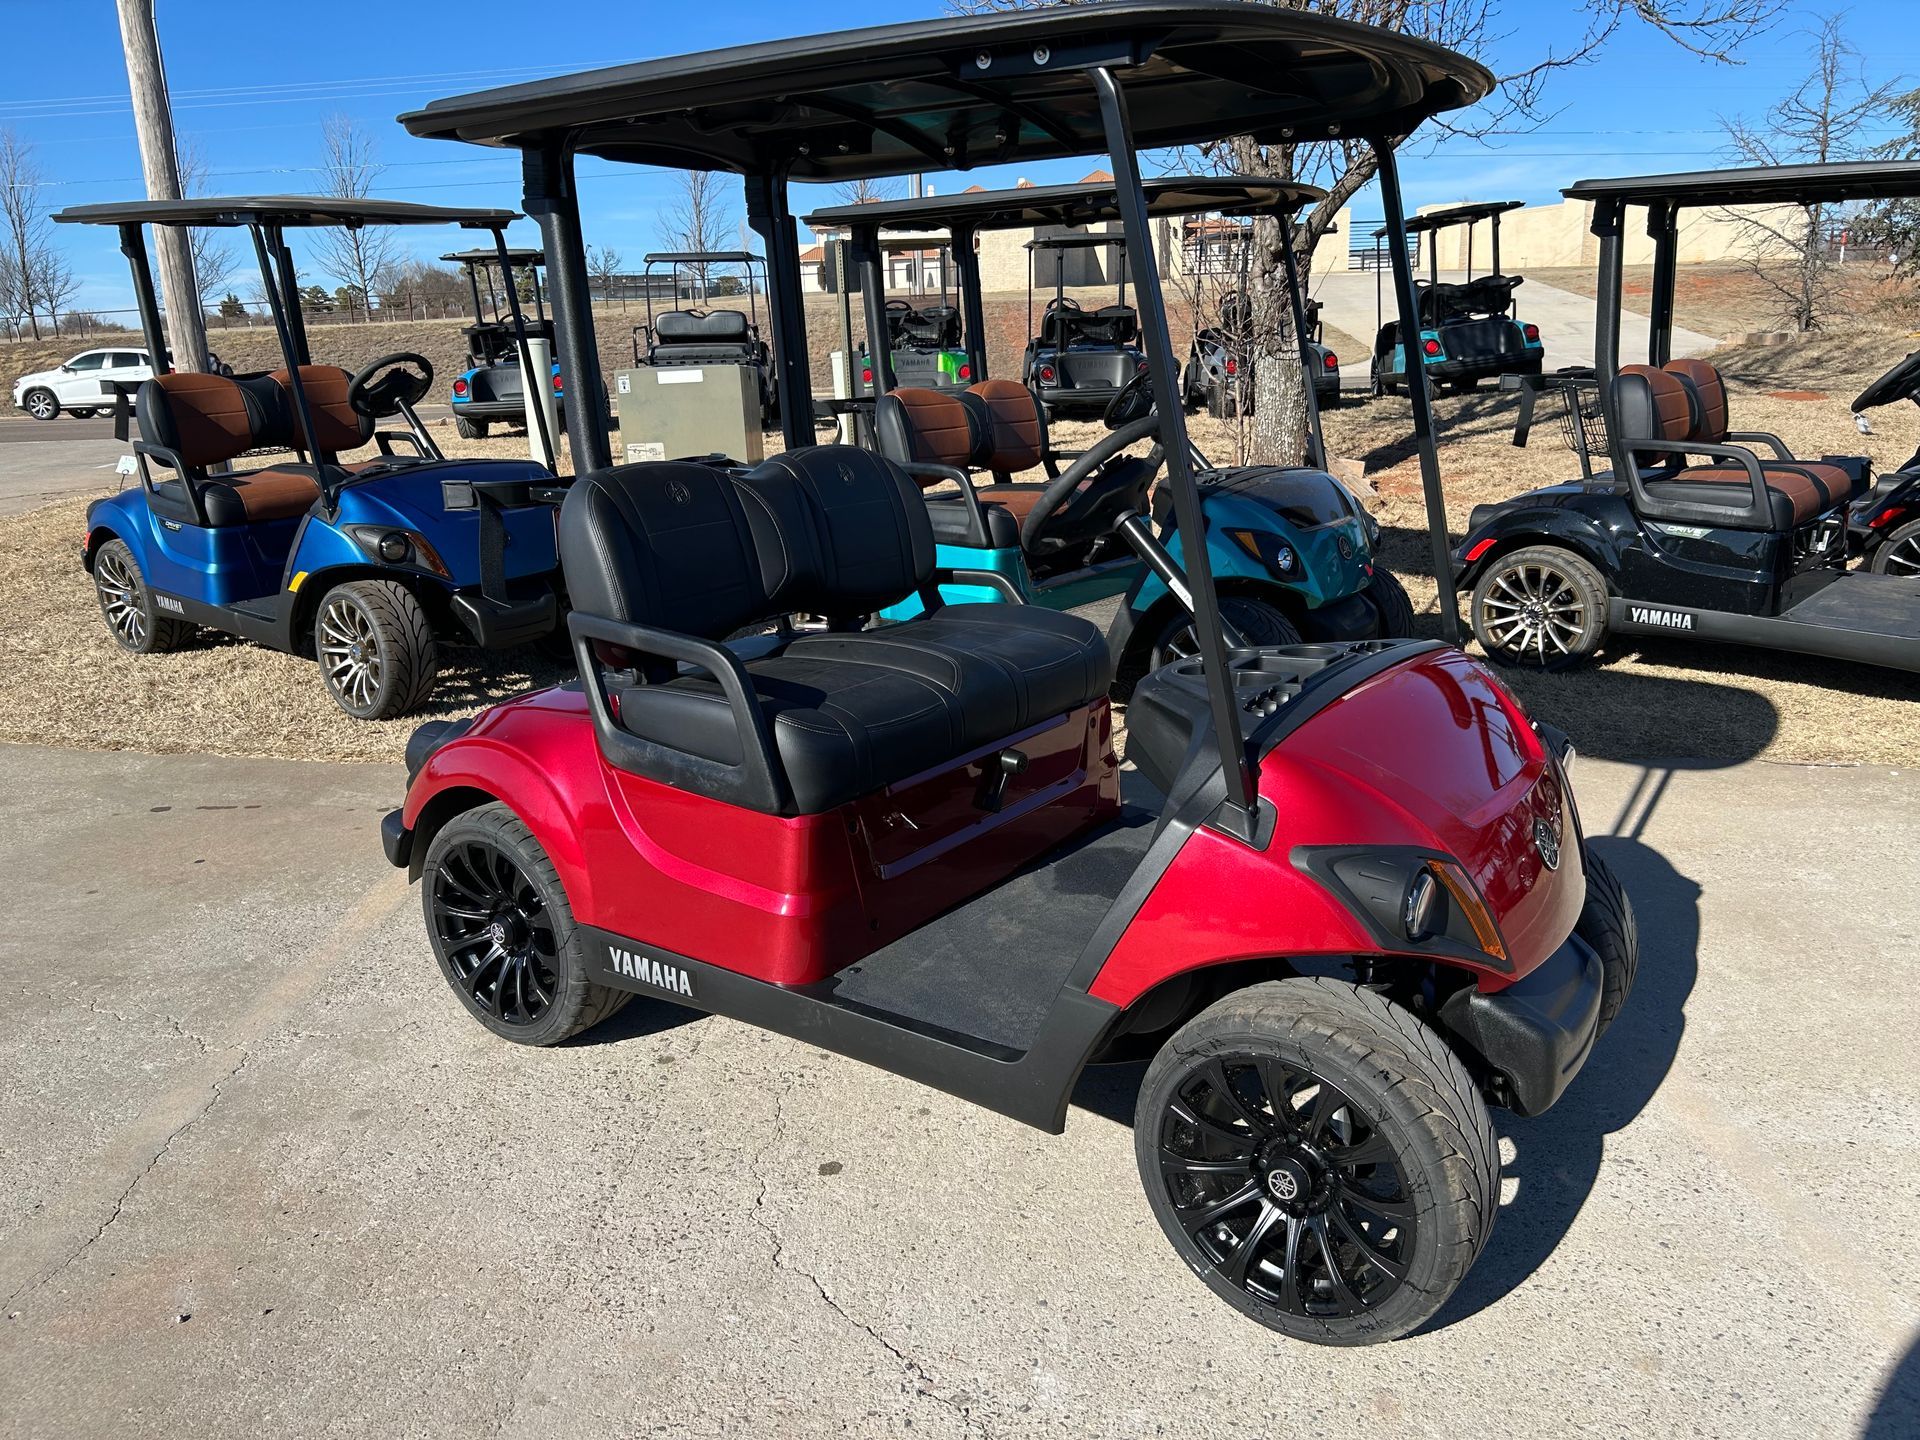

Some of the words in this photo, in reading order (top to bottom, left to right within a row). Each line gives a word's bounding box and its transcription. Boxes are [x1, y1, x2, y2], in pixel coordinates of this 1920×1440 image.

[901, 358, 931, 367] YAMAHA
[156, 594, 185, 615] YAMAHA
[1631, 607, 1692, 629] YAMAHA
[608, 946, 693, 997] YAMAHA
